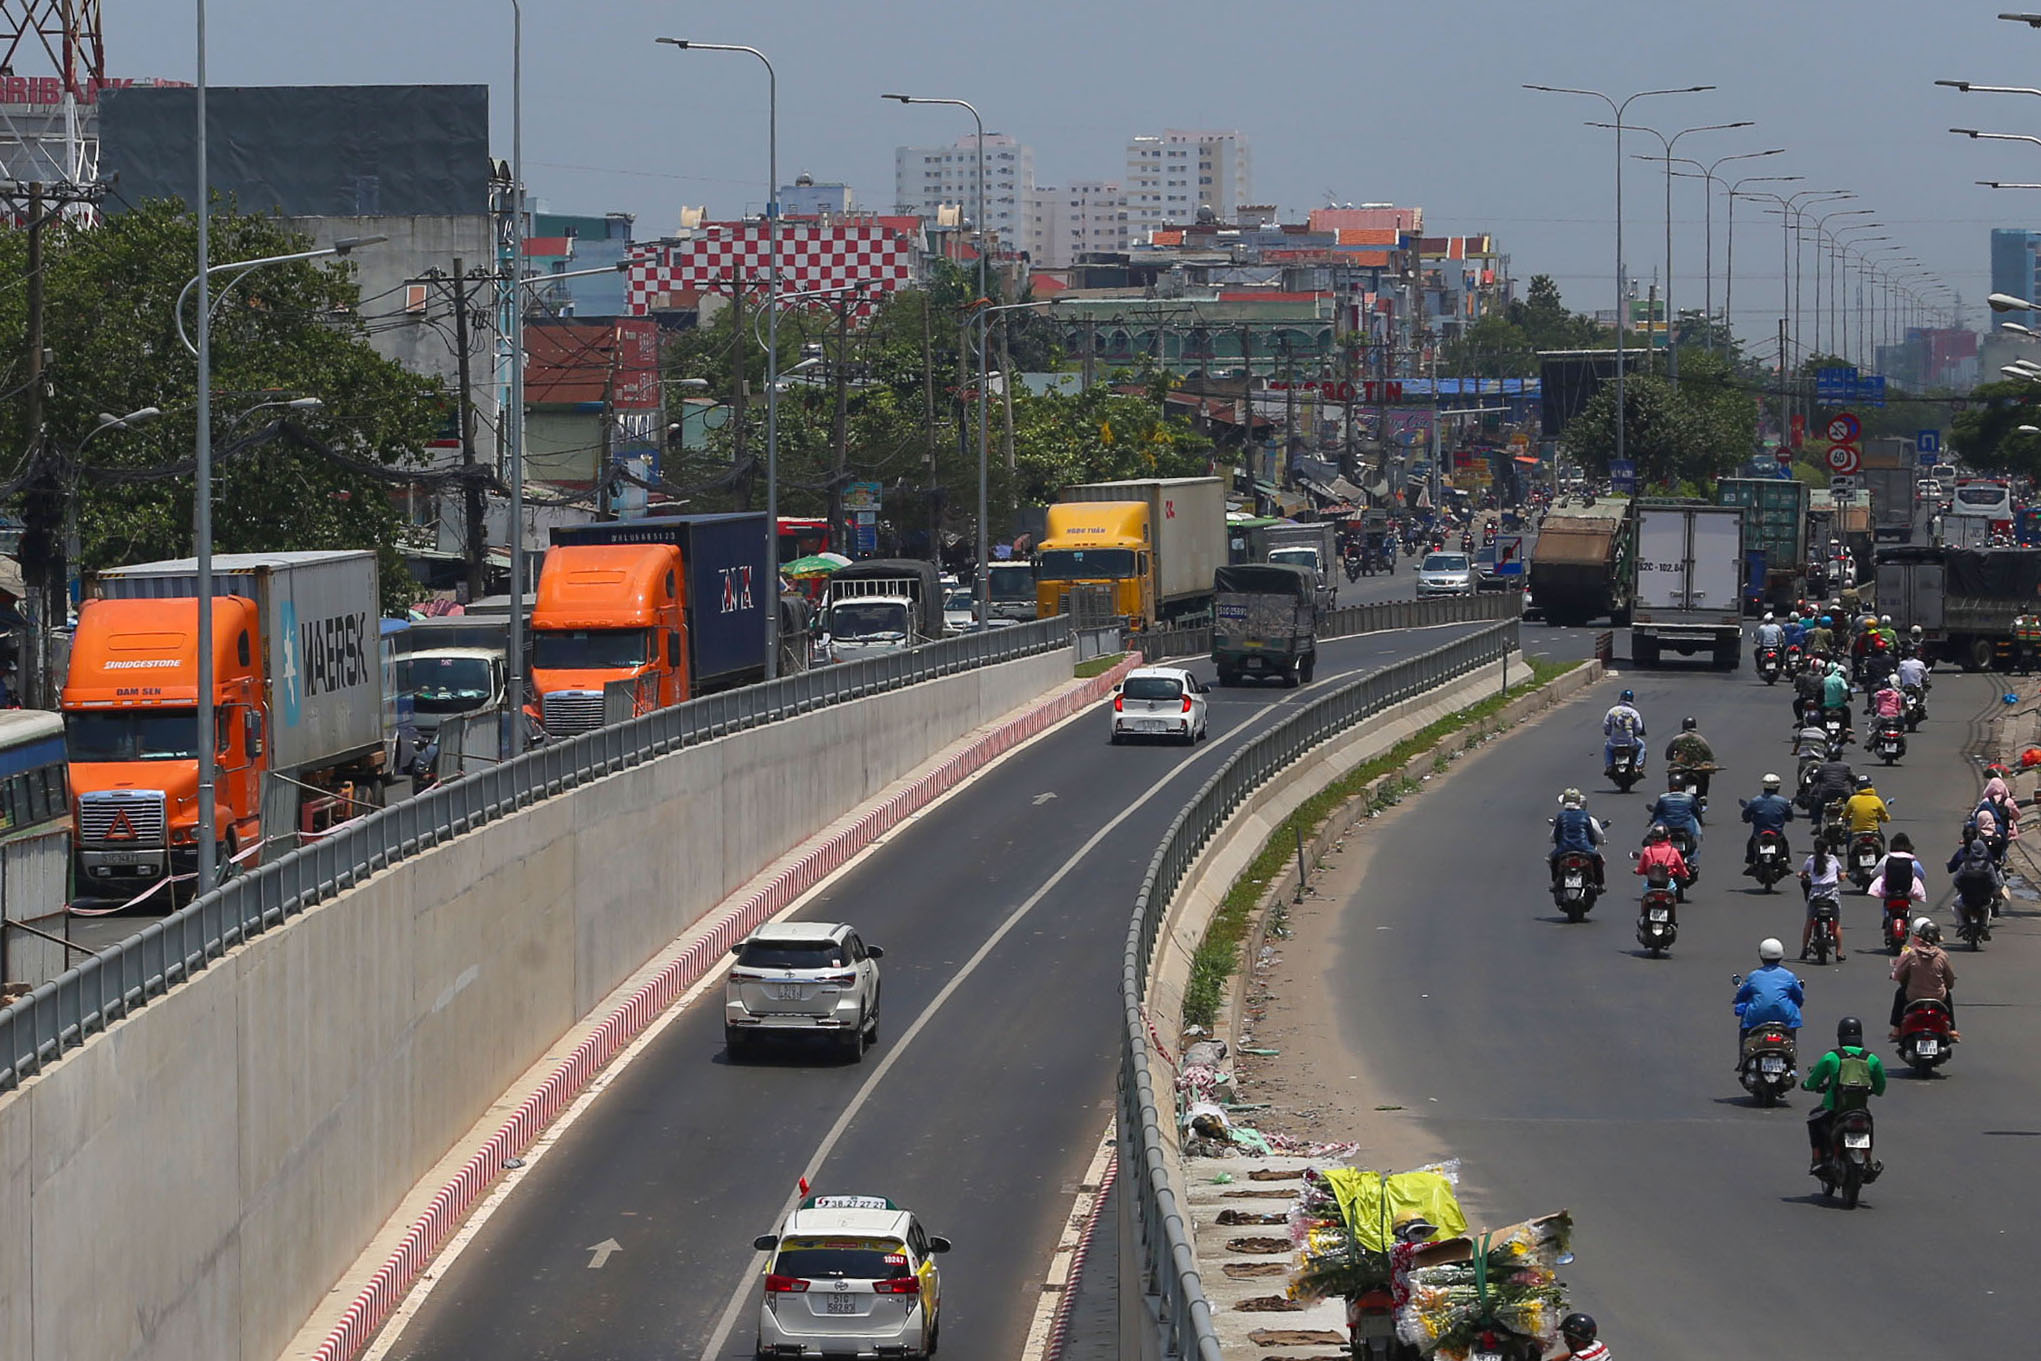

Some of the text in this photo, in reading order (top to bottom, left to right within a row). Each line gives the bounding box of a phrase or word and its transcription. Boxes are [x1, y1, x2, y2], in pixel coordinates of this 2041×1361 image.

[1833, 450, 1846, 464] 60
[301, 611, 369, 698] MAERSK
[103, 659, 182, 670] BRIDGESTONE
